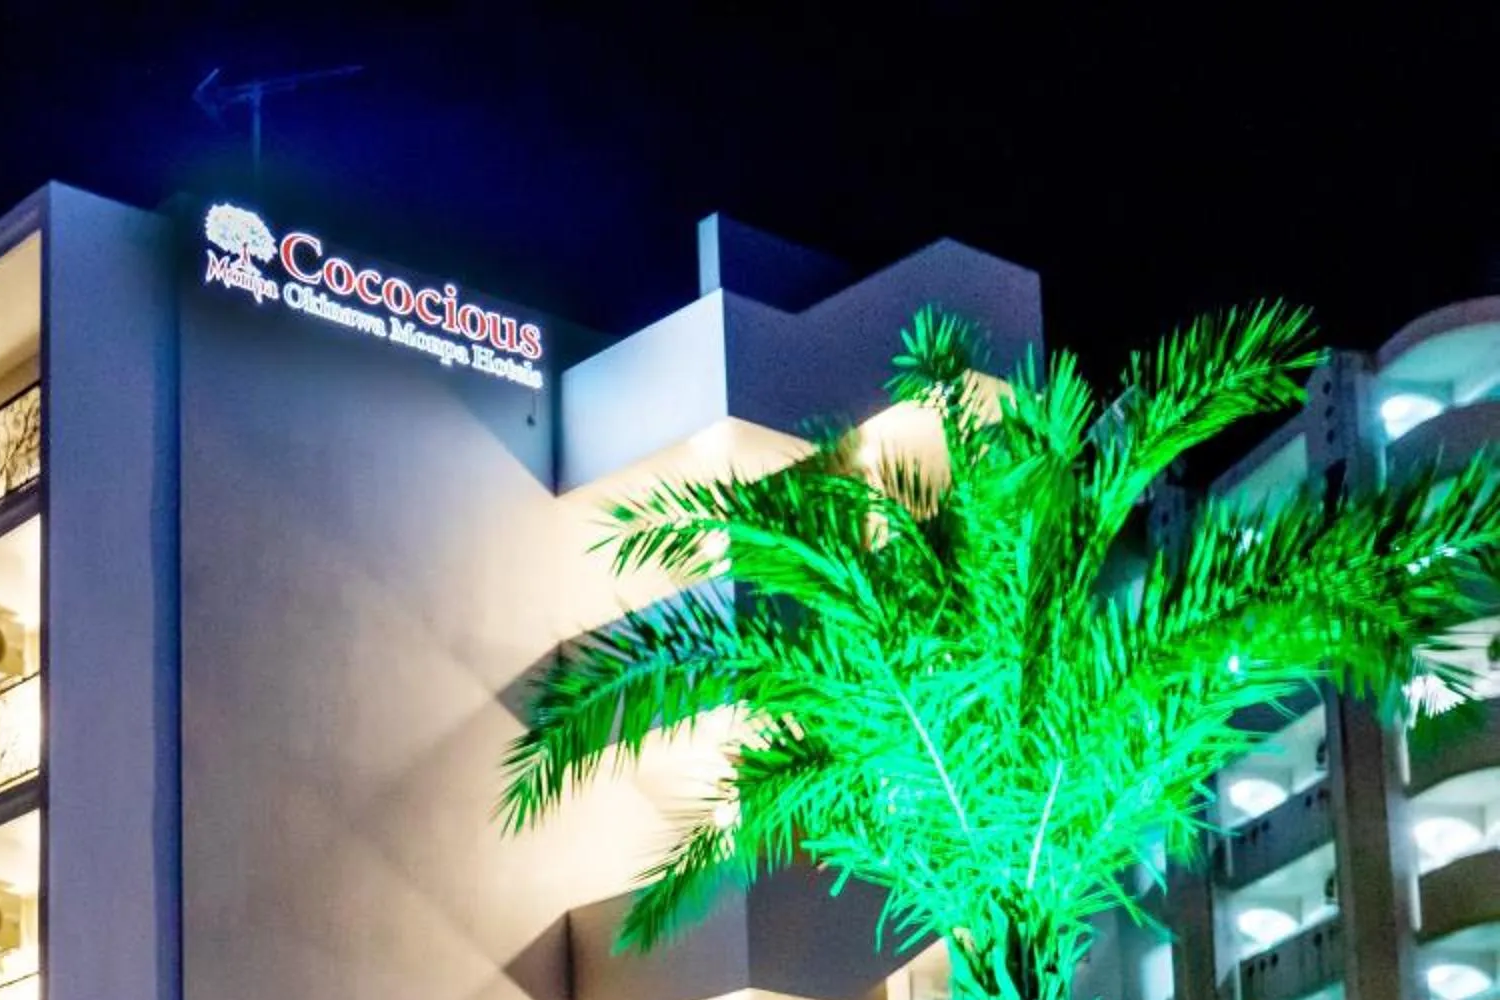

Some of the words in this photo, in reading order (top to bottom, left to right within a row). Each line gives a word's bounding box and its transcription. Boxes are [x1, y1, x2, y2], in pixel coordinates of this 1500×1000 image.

[279, 231, 544, 360] Cococious
[283, 282, 387, 338] Okinawa
[471, 344, 544, 389] Hotels
